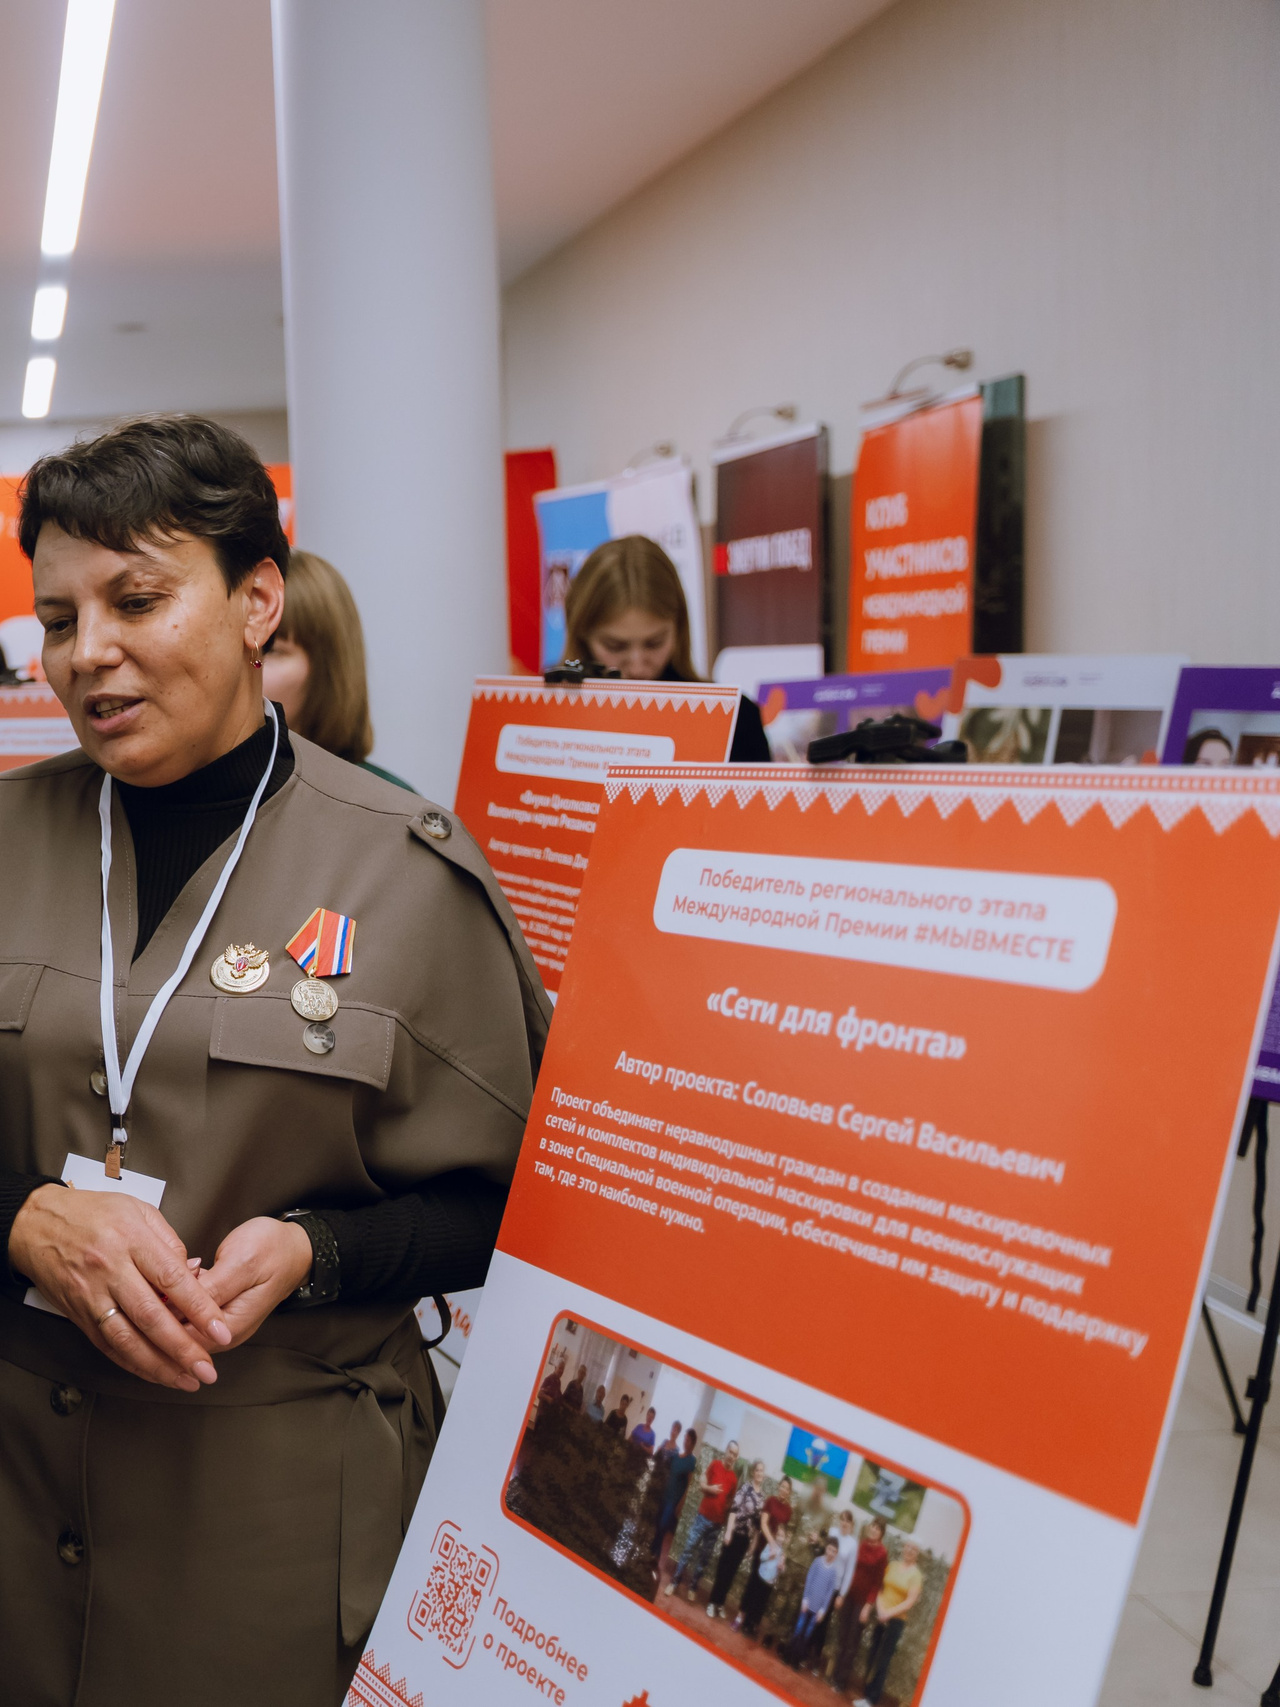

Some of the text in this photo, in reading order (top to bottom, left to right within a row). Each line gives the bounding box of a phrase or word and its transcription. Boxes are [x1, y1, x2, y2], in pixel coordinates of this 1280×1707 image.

[672, 895, 1075, 963] Международной Премии #МЫВМЕСТЕ
[699, 868, 1047, 922] Победитель регионального этапа
[706, 986, 966, 1060] «Сети для фронта»
[614, 1050, 1066, 1185] Автор проекта: Соловьев Сергей Васильевич
[534, 1160, 706, 1234] там, где это наиболее нужно.
[545, 1112, 1086, 1295] сетей и комплектов индивидуальной маскировки для военнослужащих
[550, 1086, 1113, 1268] Проект объединяет неравнодушных граждан в создании маскировочных
[539, 1137, 1149, 1360] в зоне Специальной военной операции, обеспечивая им защиту и поддержку
[483, 1633, 566, 1707] о проекте
[492, 1596, 589, 1682] Подробнее
